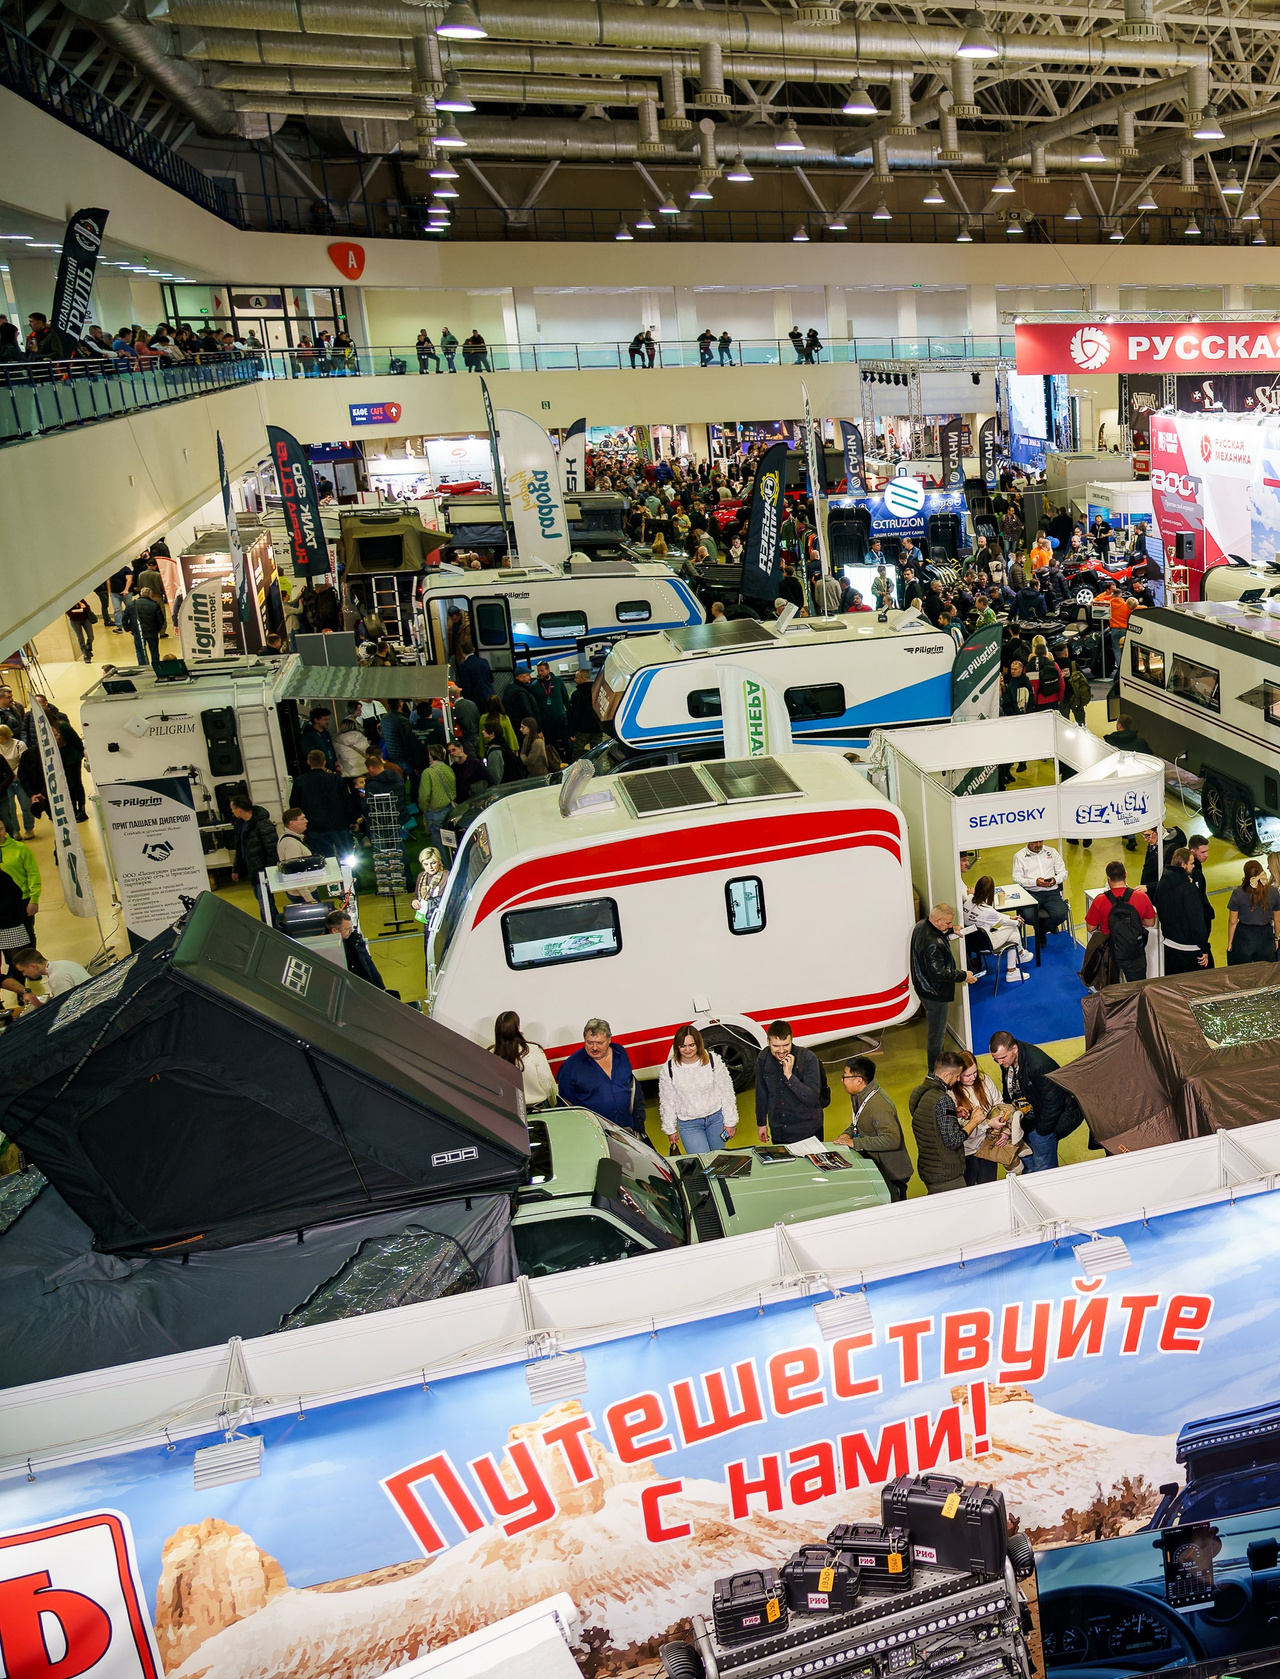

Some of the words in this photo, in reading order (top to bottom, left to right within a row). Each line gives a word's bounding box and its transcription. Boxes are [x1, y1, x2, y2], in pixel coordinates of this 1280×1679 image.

[57, 256, 78, 331] СЛАВЯНСКИЙ
[65, 267, 93, 341] ГРИЛЬ
[352, 407, 368, 416] КАФЕ
[949, 431, 959, 469] САНИ
[983, 430, 993, 468] САНИ
[1215, 438, 1245, 450] РУССКАЯ
[1215, 451, 1251, 465] МЕХАНИКА
[872, 518, 924, 530] EXTRUZION
[914, 645, 944, 655] Piligrim
[967, 640, 998, 674] Piligrim
[150, 723, 196, 737] PILIGRIM
[122, 796, 163, 808] Piligrim
[112, 818, 158, 830] ПРИГЛАШАЕМ
[159, 814, 191, 826] ДИЛЕРОВ!
[969, 808, 1046, 829] SEATOSKY
[384, 1277, 1212, 1554] Путешествуйте
[642, 1480, 690, 1542] с
[726, 1382, 990, 1520] нами!
[859, 1557, 875, 1566] РИФ
[915, 1550, 935, 1560] РИФ
[809, 1596, 829, 1605] РИФ
[743, 1615, 761, 1627] РИФ
